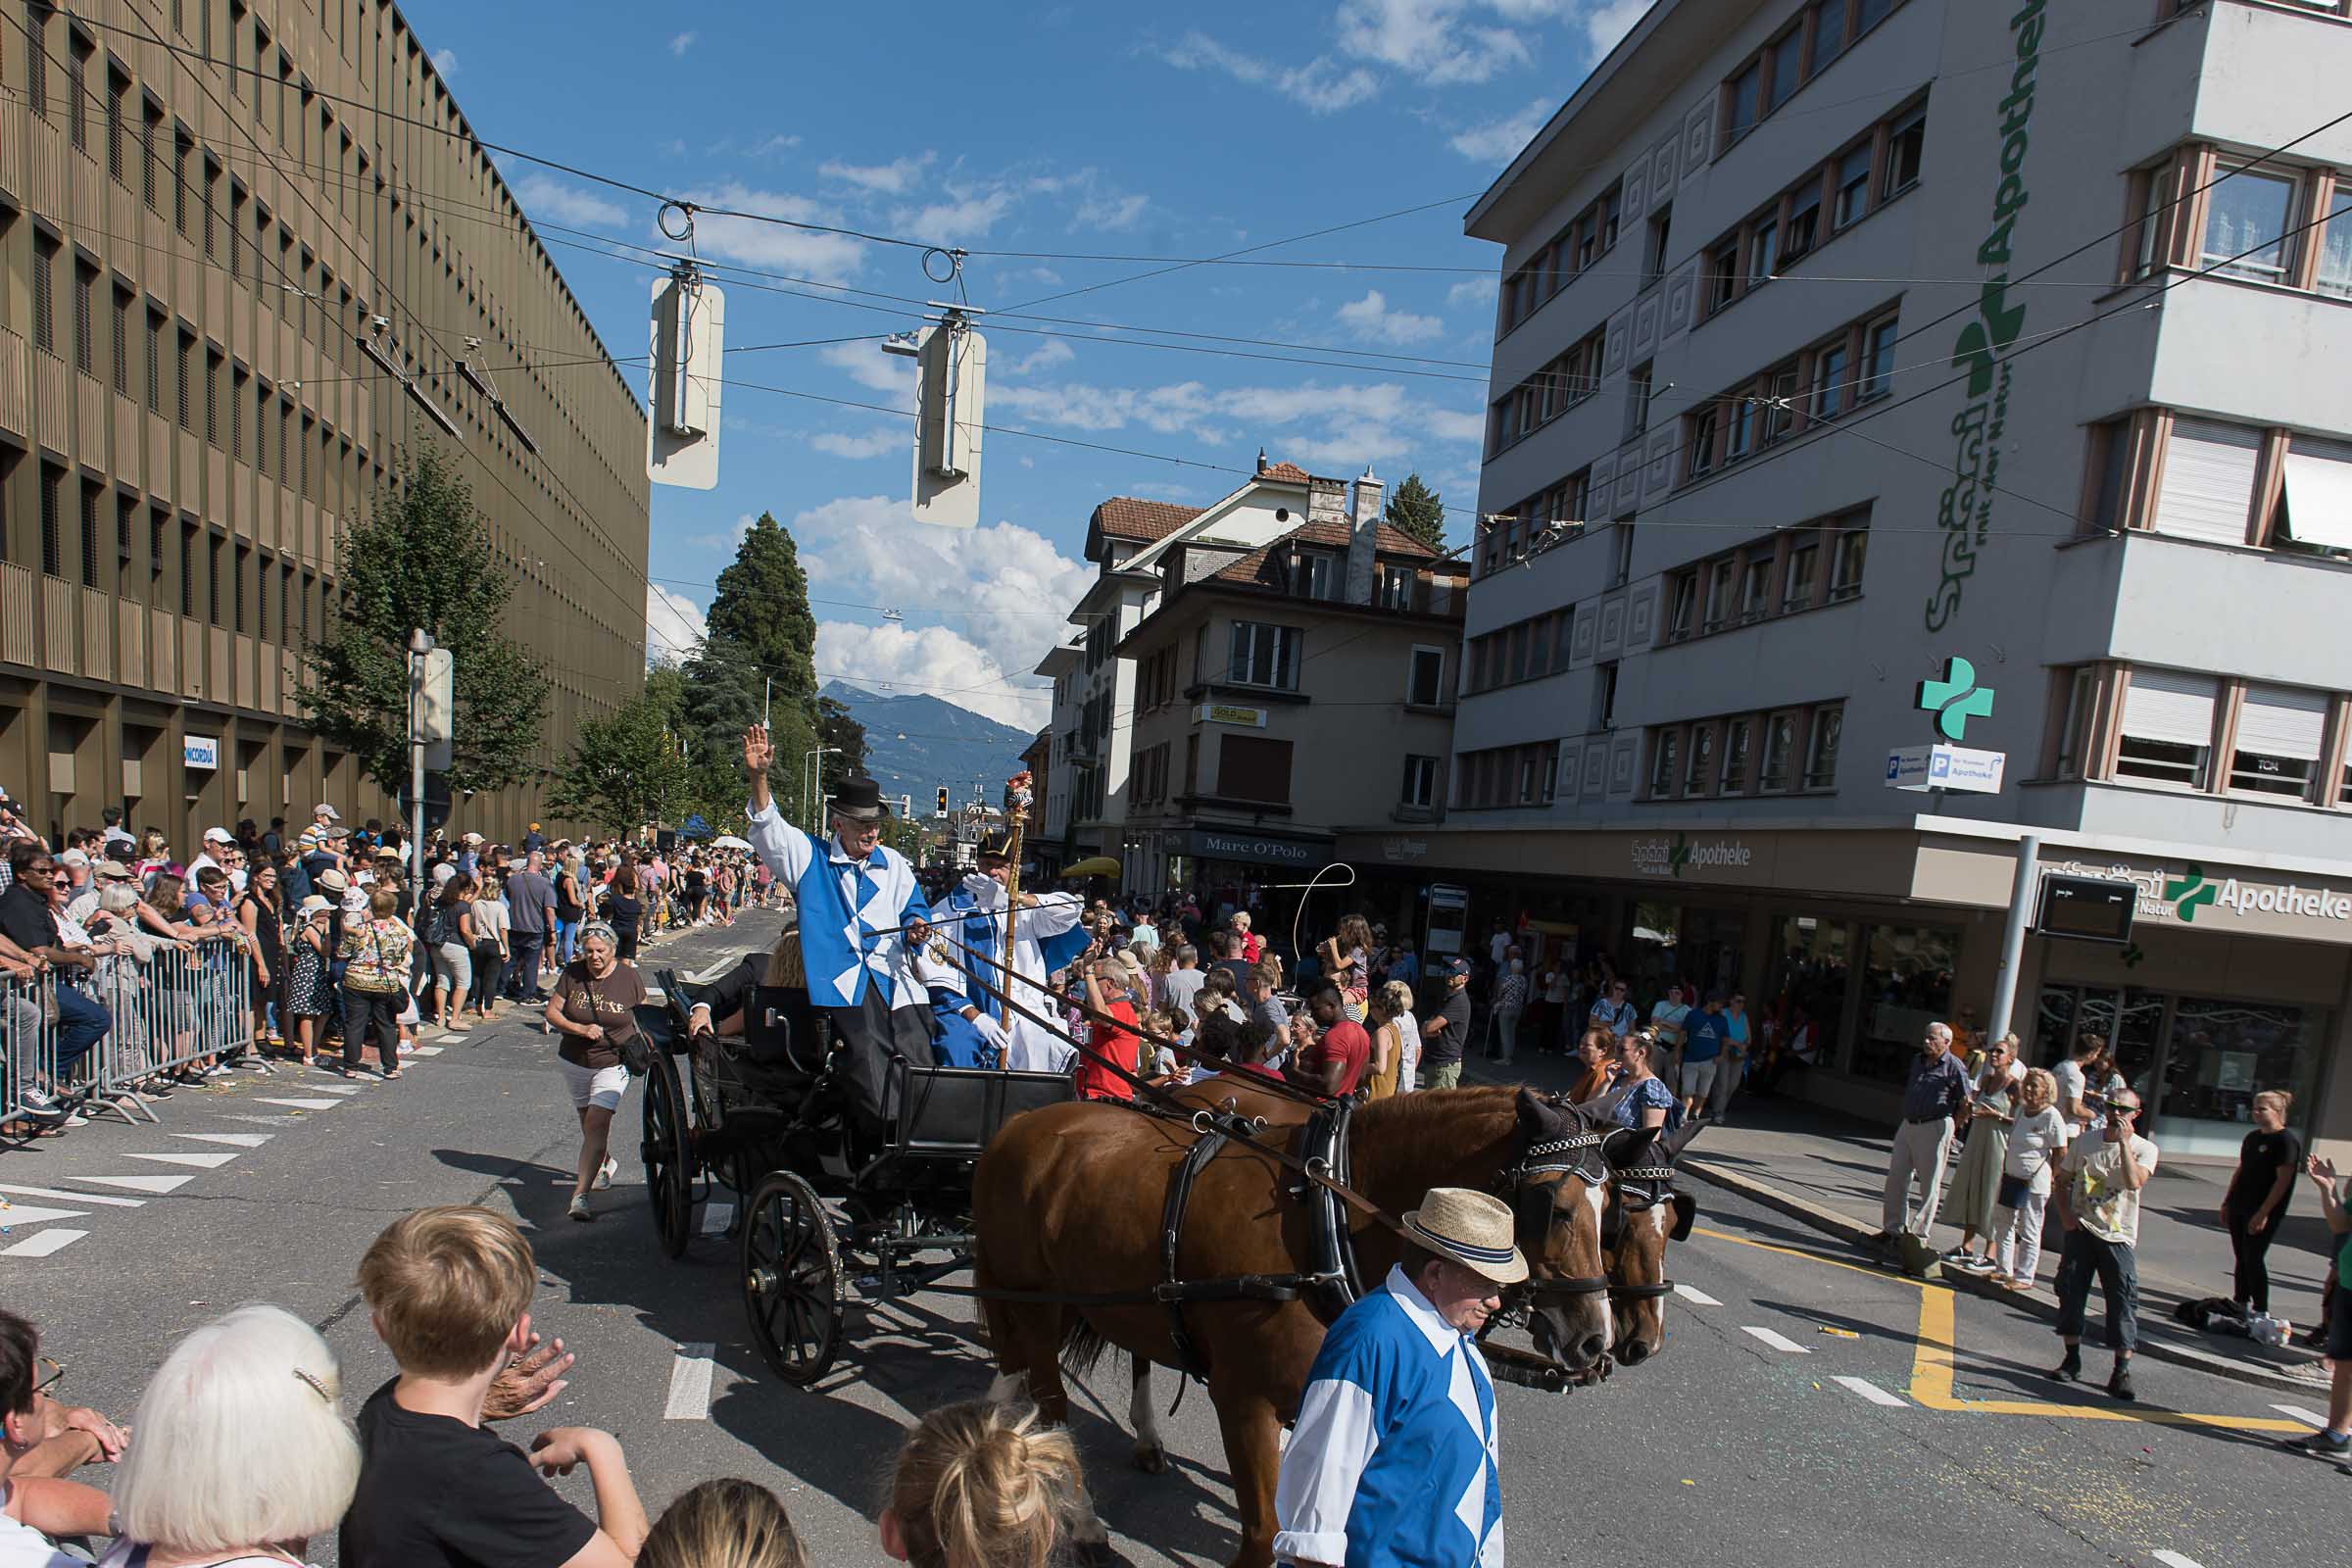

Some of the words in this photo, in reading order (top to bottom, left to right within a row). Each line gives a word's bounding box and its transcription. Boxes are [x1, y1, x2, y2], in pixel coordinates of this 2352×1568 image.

[1206, 837, 1250, 853] Marc
[1253, 842, 1307, 858] O'Polo
[1690, 840, 1751, 870] Apotheke
[2140, 899, 2175, 917] Natur
[2217, 878, 2351, 920] Apotheke
